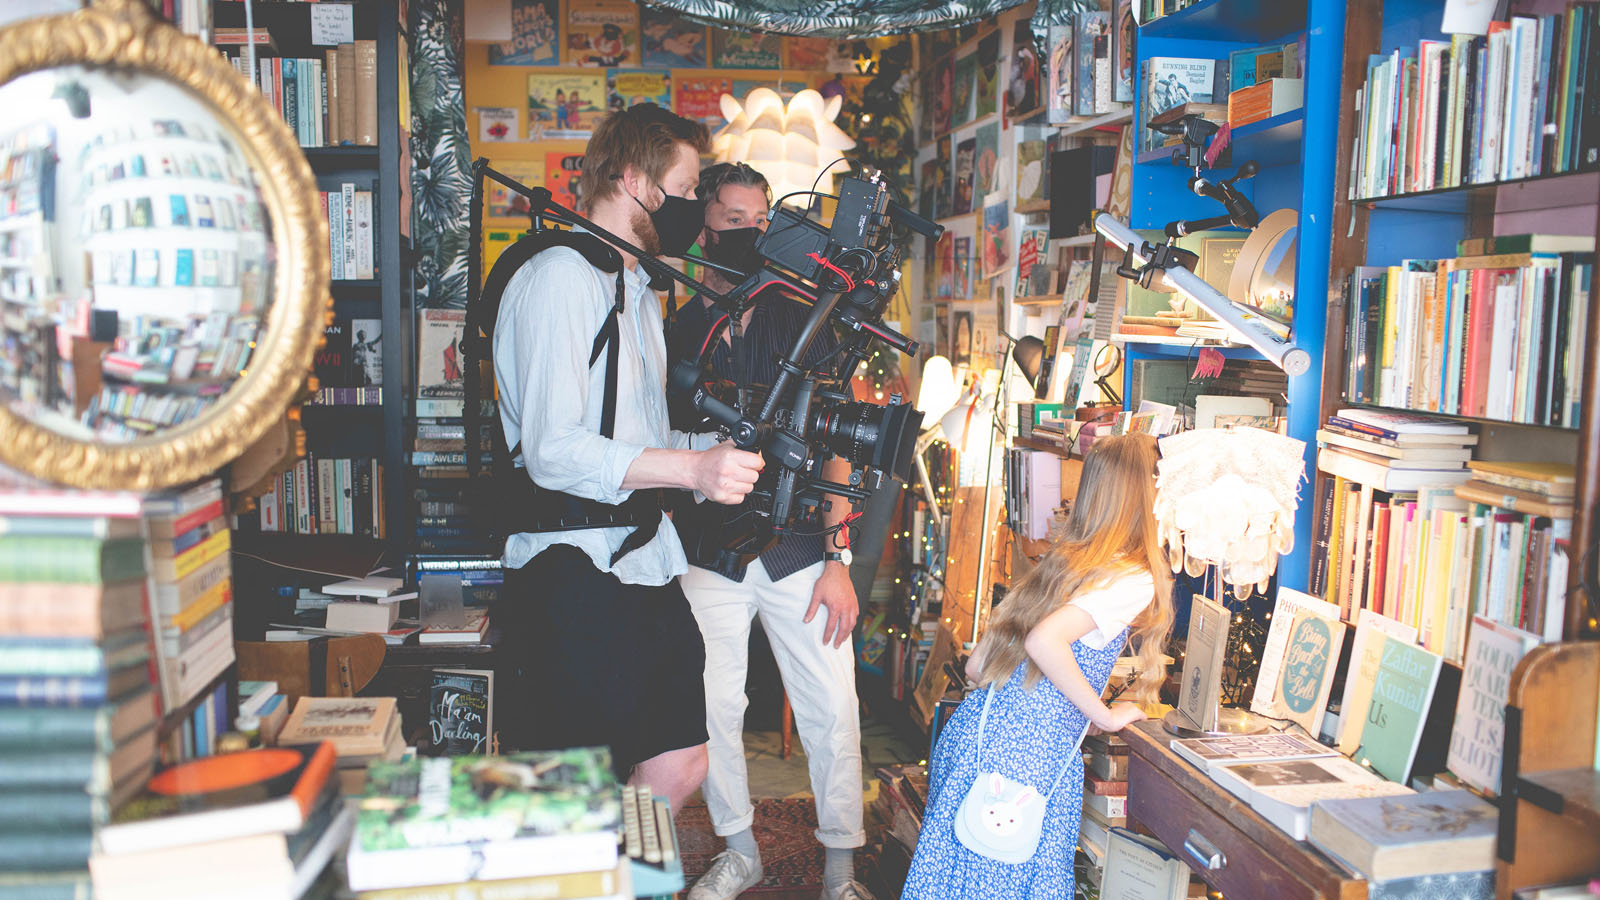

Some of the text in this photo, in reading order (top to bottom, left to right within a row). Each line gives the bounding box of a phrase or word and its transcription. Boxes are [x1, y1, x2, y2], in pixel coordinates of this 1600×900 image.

[423, 455, 464, 463] TRAWLER
[422, 560, 502, 570] WEEKEND NAVIGATOR
[1382, 640, 1429, 680] Zaffar
[1476, 639, 1516, 676] FOUR
[1289, 675, 1318, 701] Bells
[1374, 670, 1425, 713] Kunial
[441, 690, 482, 724] Ma'am
[1368, 699, 1388, 728] Us
[429, 720, 487, 753] Darling
[1450, 730, 1499, 778] ELIOT
